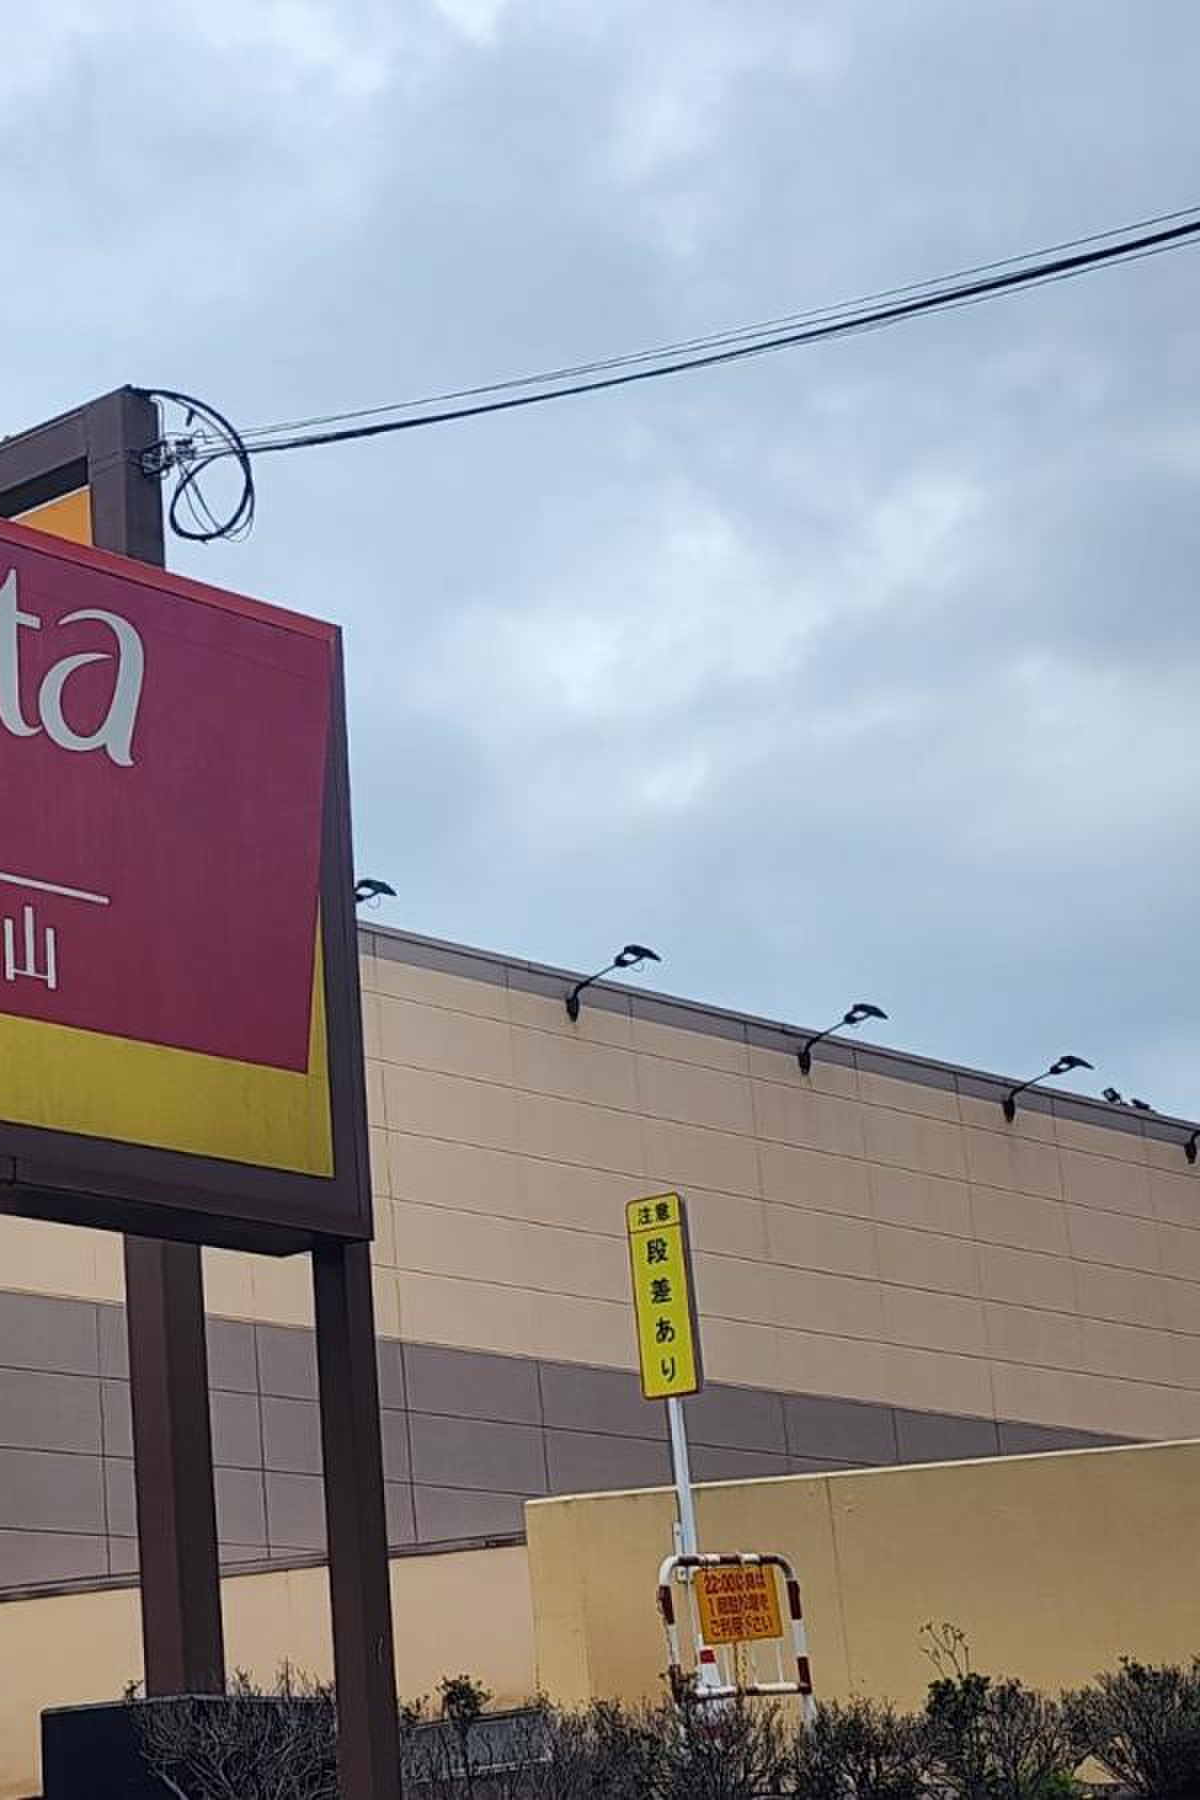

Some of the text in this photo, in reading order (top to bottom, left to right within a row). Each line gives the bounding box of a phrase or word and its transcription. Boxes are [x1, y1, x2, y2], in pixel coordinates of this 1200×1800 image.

[638, 1203, 670, 1226] 注意
[646, 1238, 676, 1382] 段差あり
